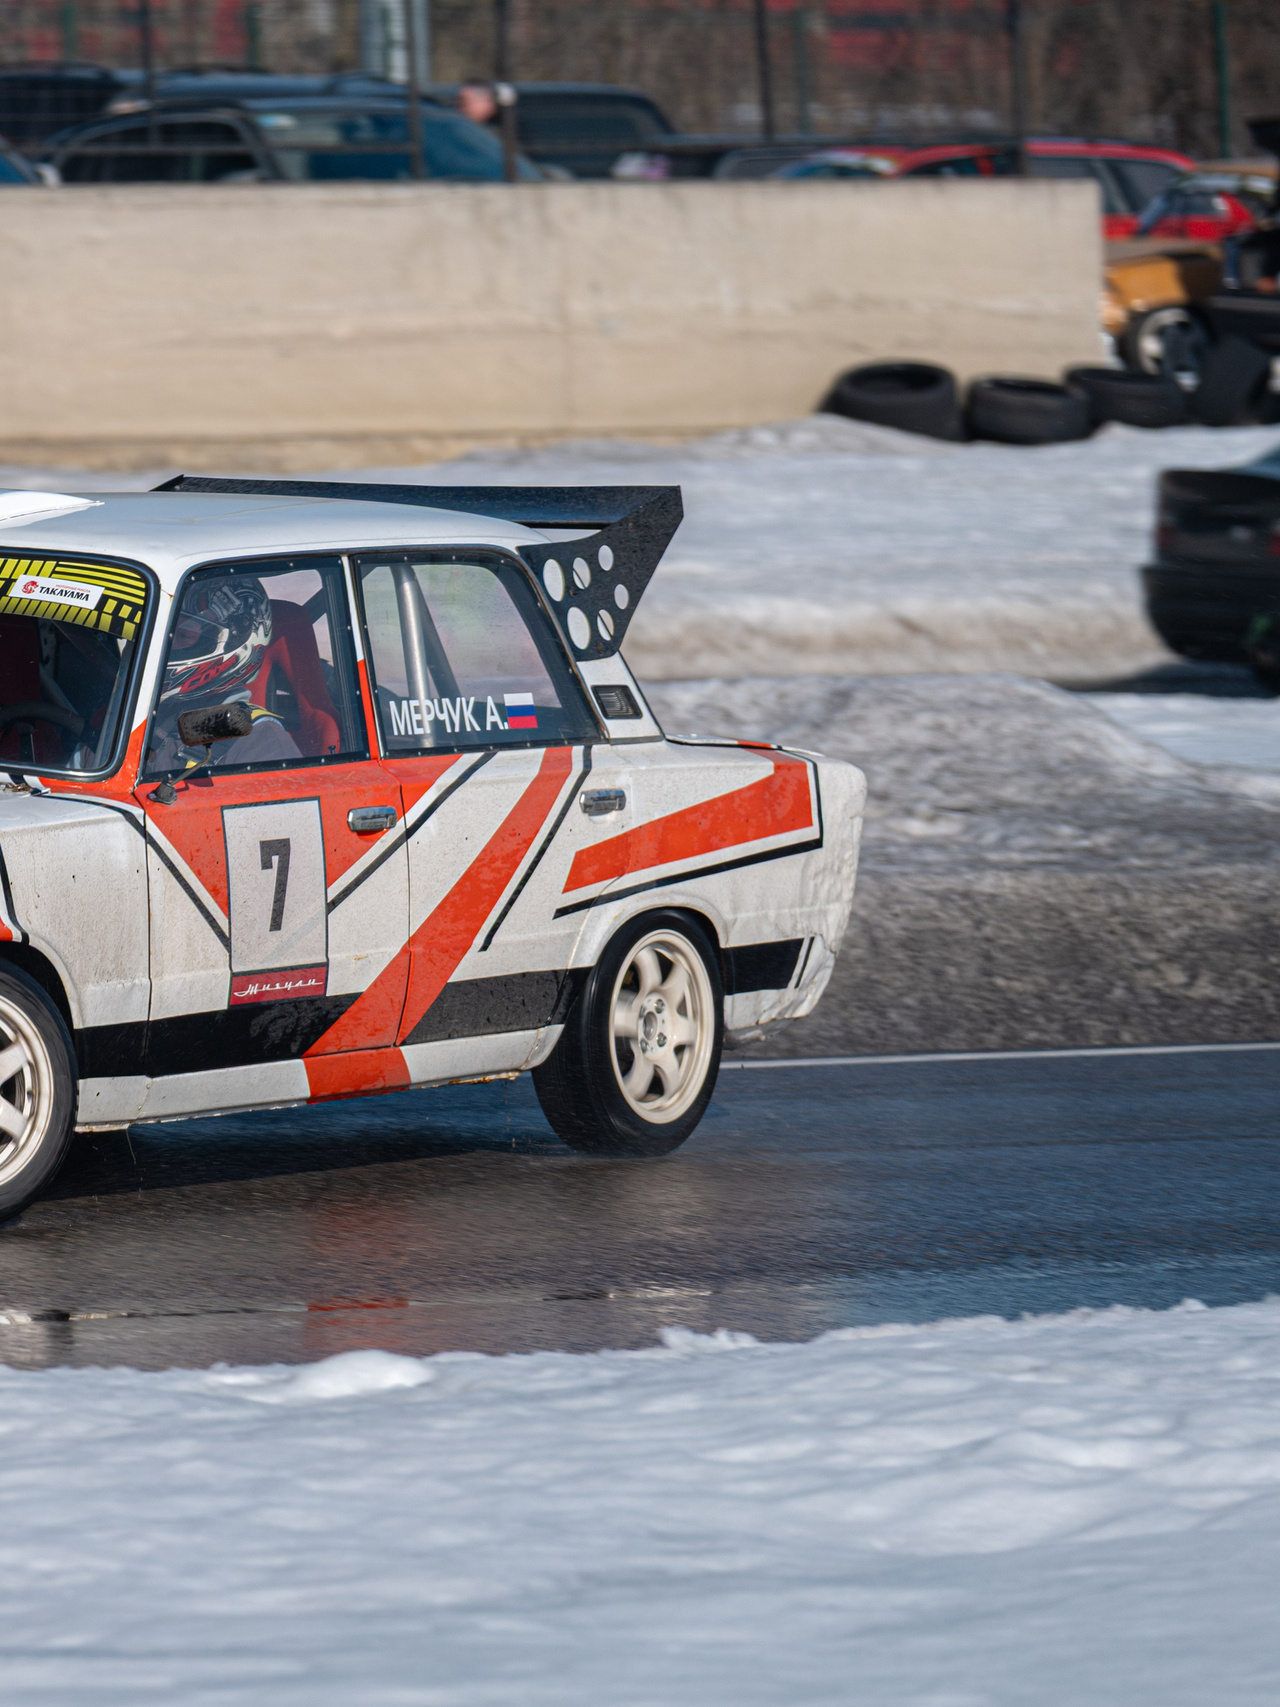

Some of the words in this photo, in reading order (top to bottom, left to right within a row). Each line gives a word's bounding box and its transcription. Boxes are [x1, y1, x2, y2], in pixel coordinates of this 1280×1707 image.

[39, 586, 90, 602] TAKAYAMA
[389, 697, 481, 736] МЕРЧУК
[259, 837, 291, 932] 7
